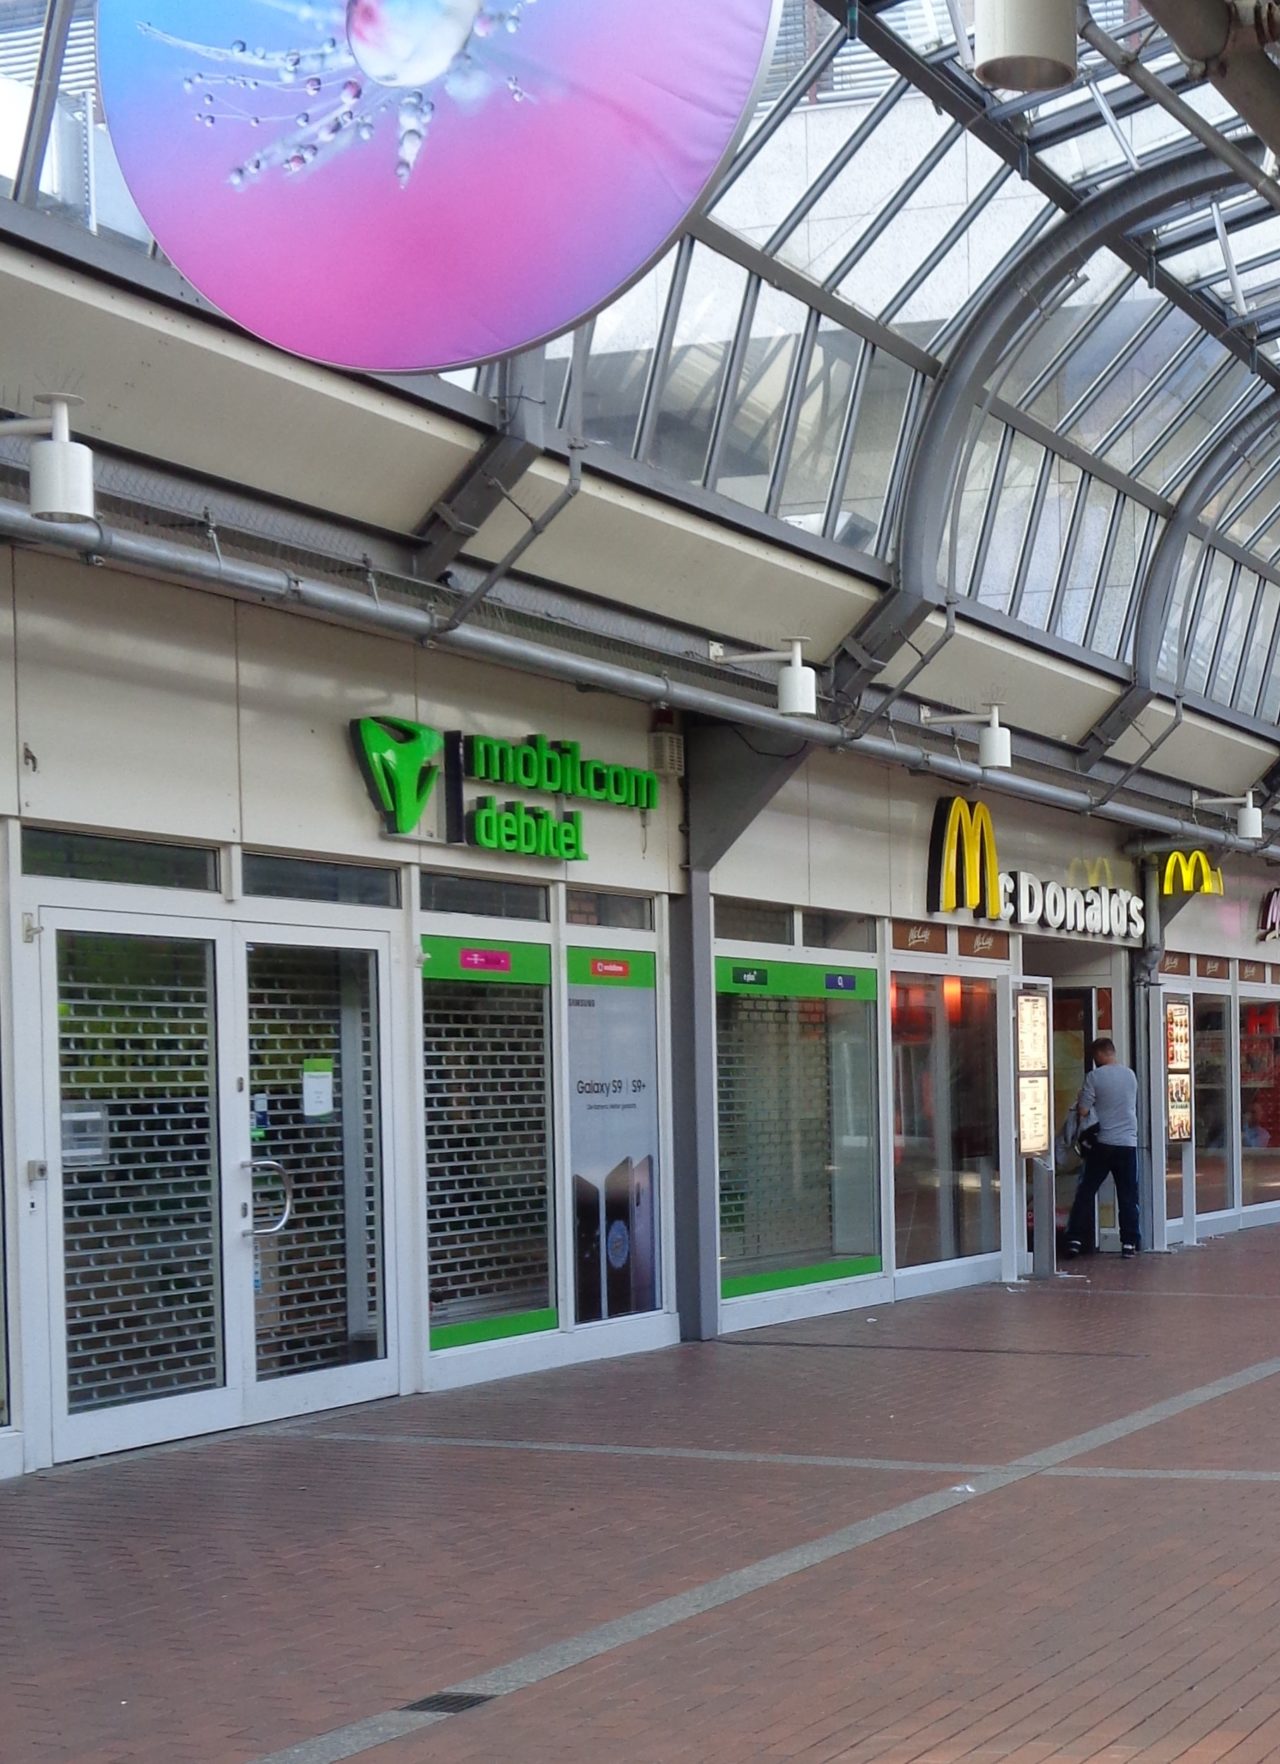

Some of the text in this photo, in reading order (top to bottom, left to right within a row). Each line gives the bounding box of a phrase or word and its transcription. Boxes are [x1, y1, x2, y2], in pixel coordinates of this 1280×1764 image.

[465, 734, 658, 809] mobilcom
[465, 796, 588, 861] debitel
[930, 796, 1145, 939] McDonald's
[577, 1079, 646, 1097] Galaxy S9 S9+
